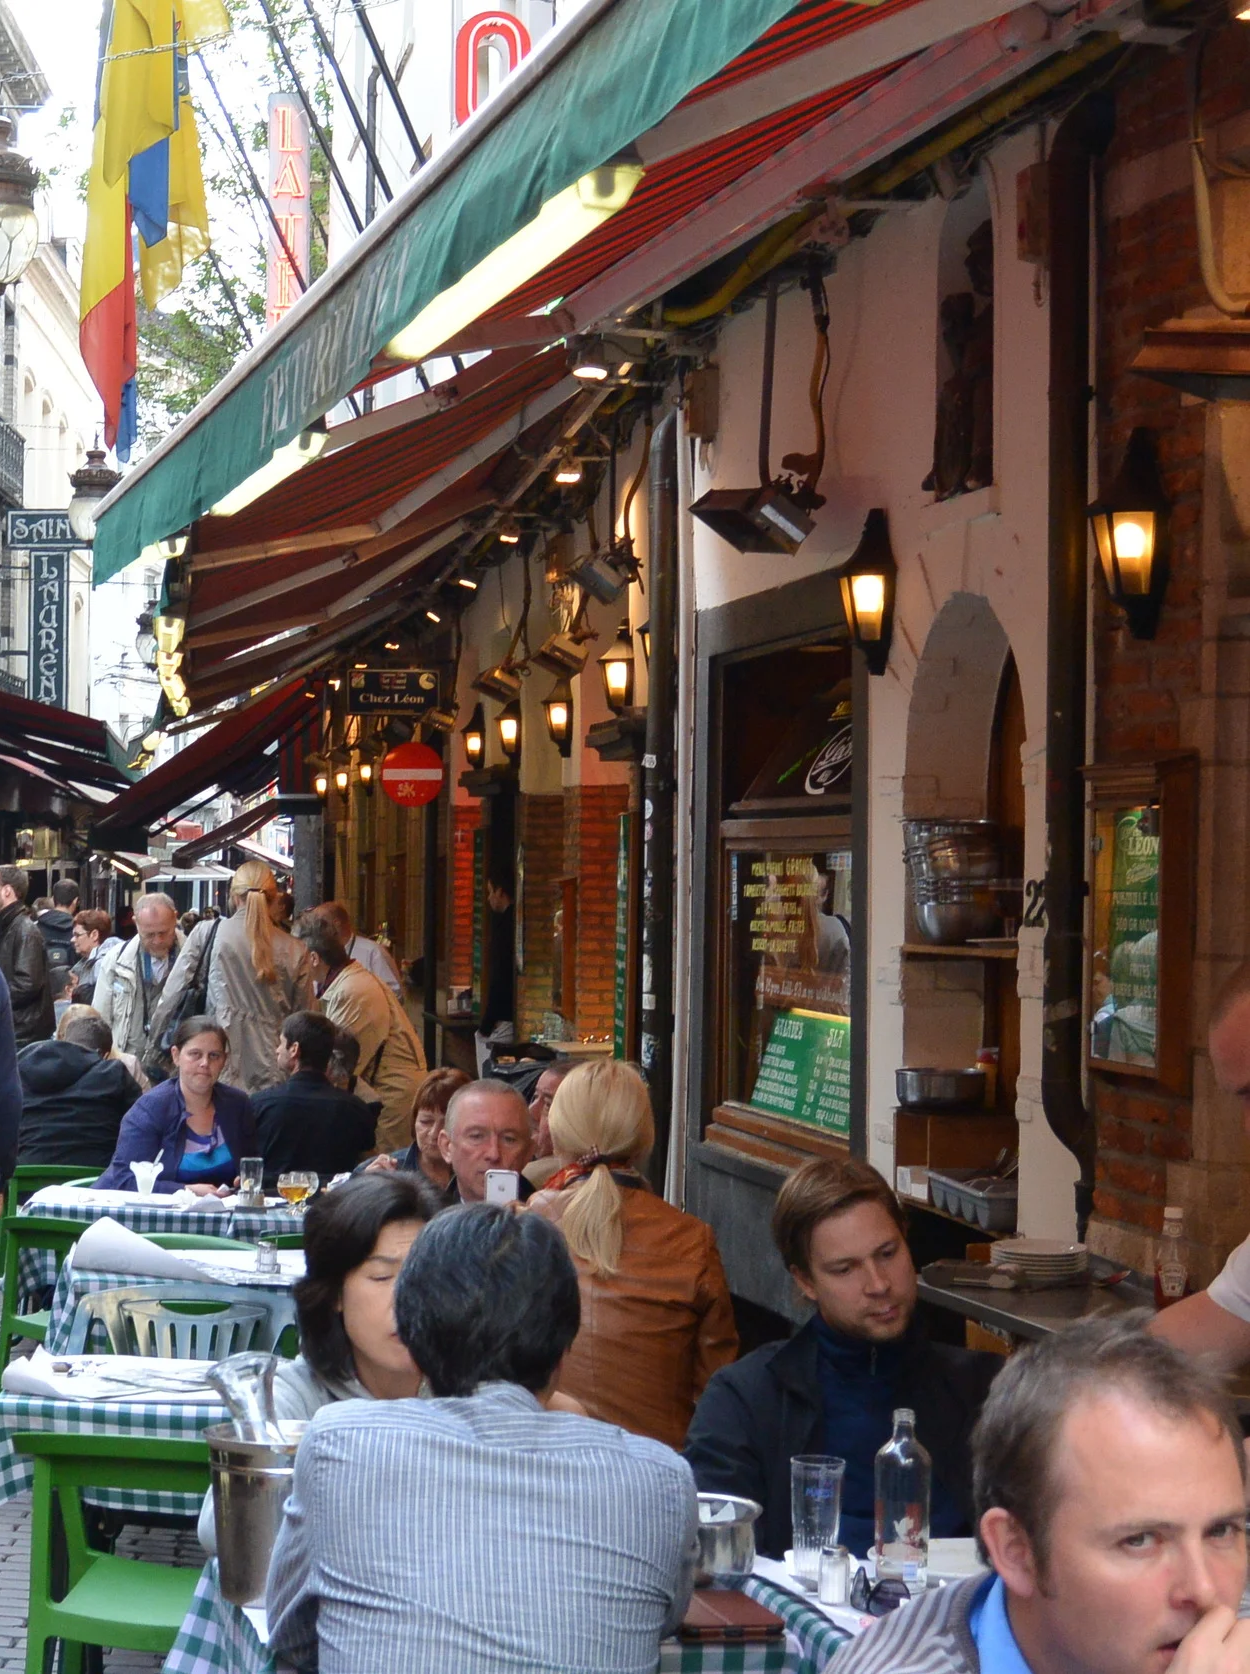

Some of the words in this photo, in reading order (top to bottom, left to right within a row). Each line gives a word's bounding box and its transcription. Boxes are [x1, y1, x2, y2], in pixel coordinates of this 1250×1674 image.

[12, 518, 78, 542] SAIN
[359, 692, 391, 704] Chez
[394, 692, 425, 704] Léon
